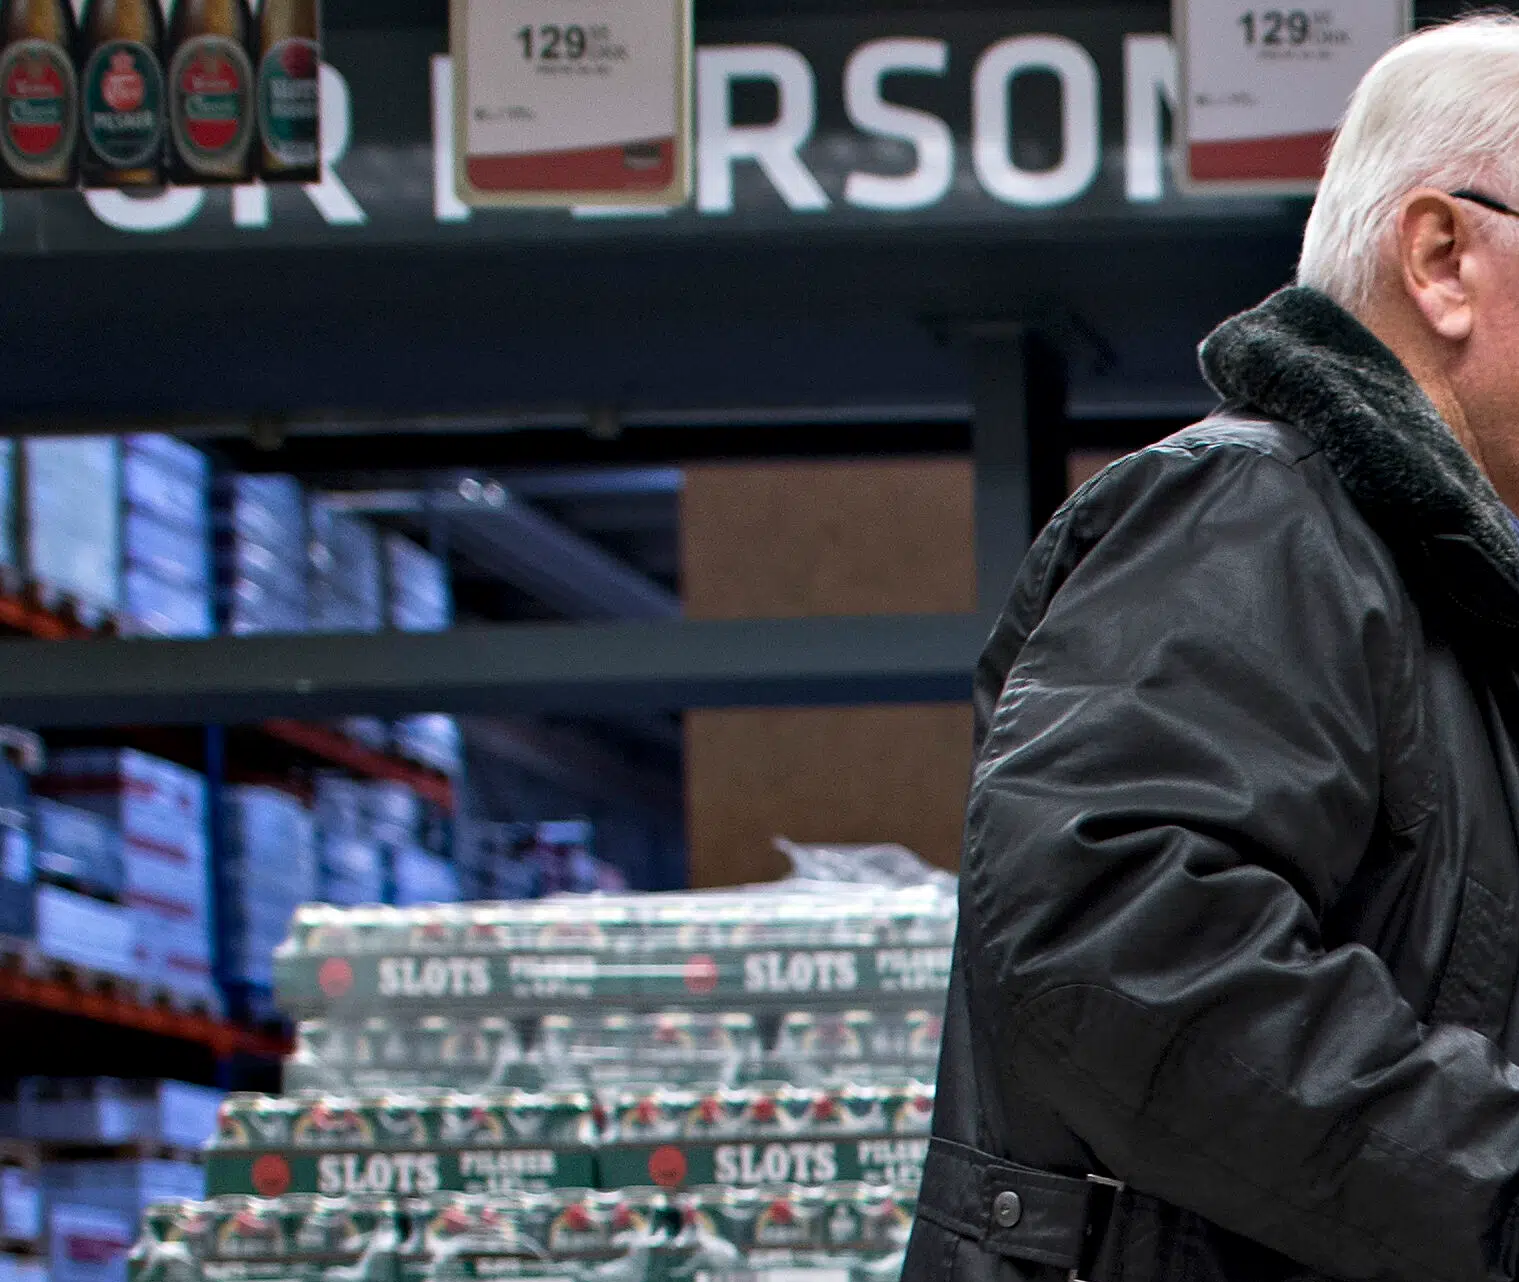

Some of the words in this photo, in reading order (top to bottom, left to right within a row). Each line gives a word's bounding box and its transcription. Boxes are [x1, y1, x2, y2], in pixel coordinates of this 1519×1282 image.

[516, 24, 586, 60] 129
[1238, 9, 1313, 46] 129
[378, 957, 490, 996] SLOTS
[744, 952, 857, 992] SLOTS
[317, 1153, 440, 1193] SLOTS
[714, 1143, 836, 1184] SLOTS
